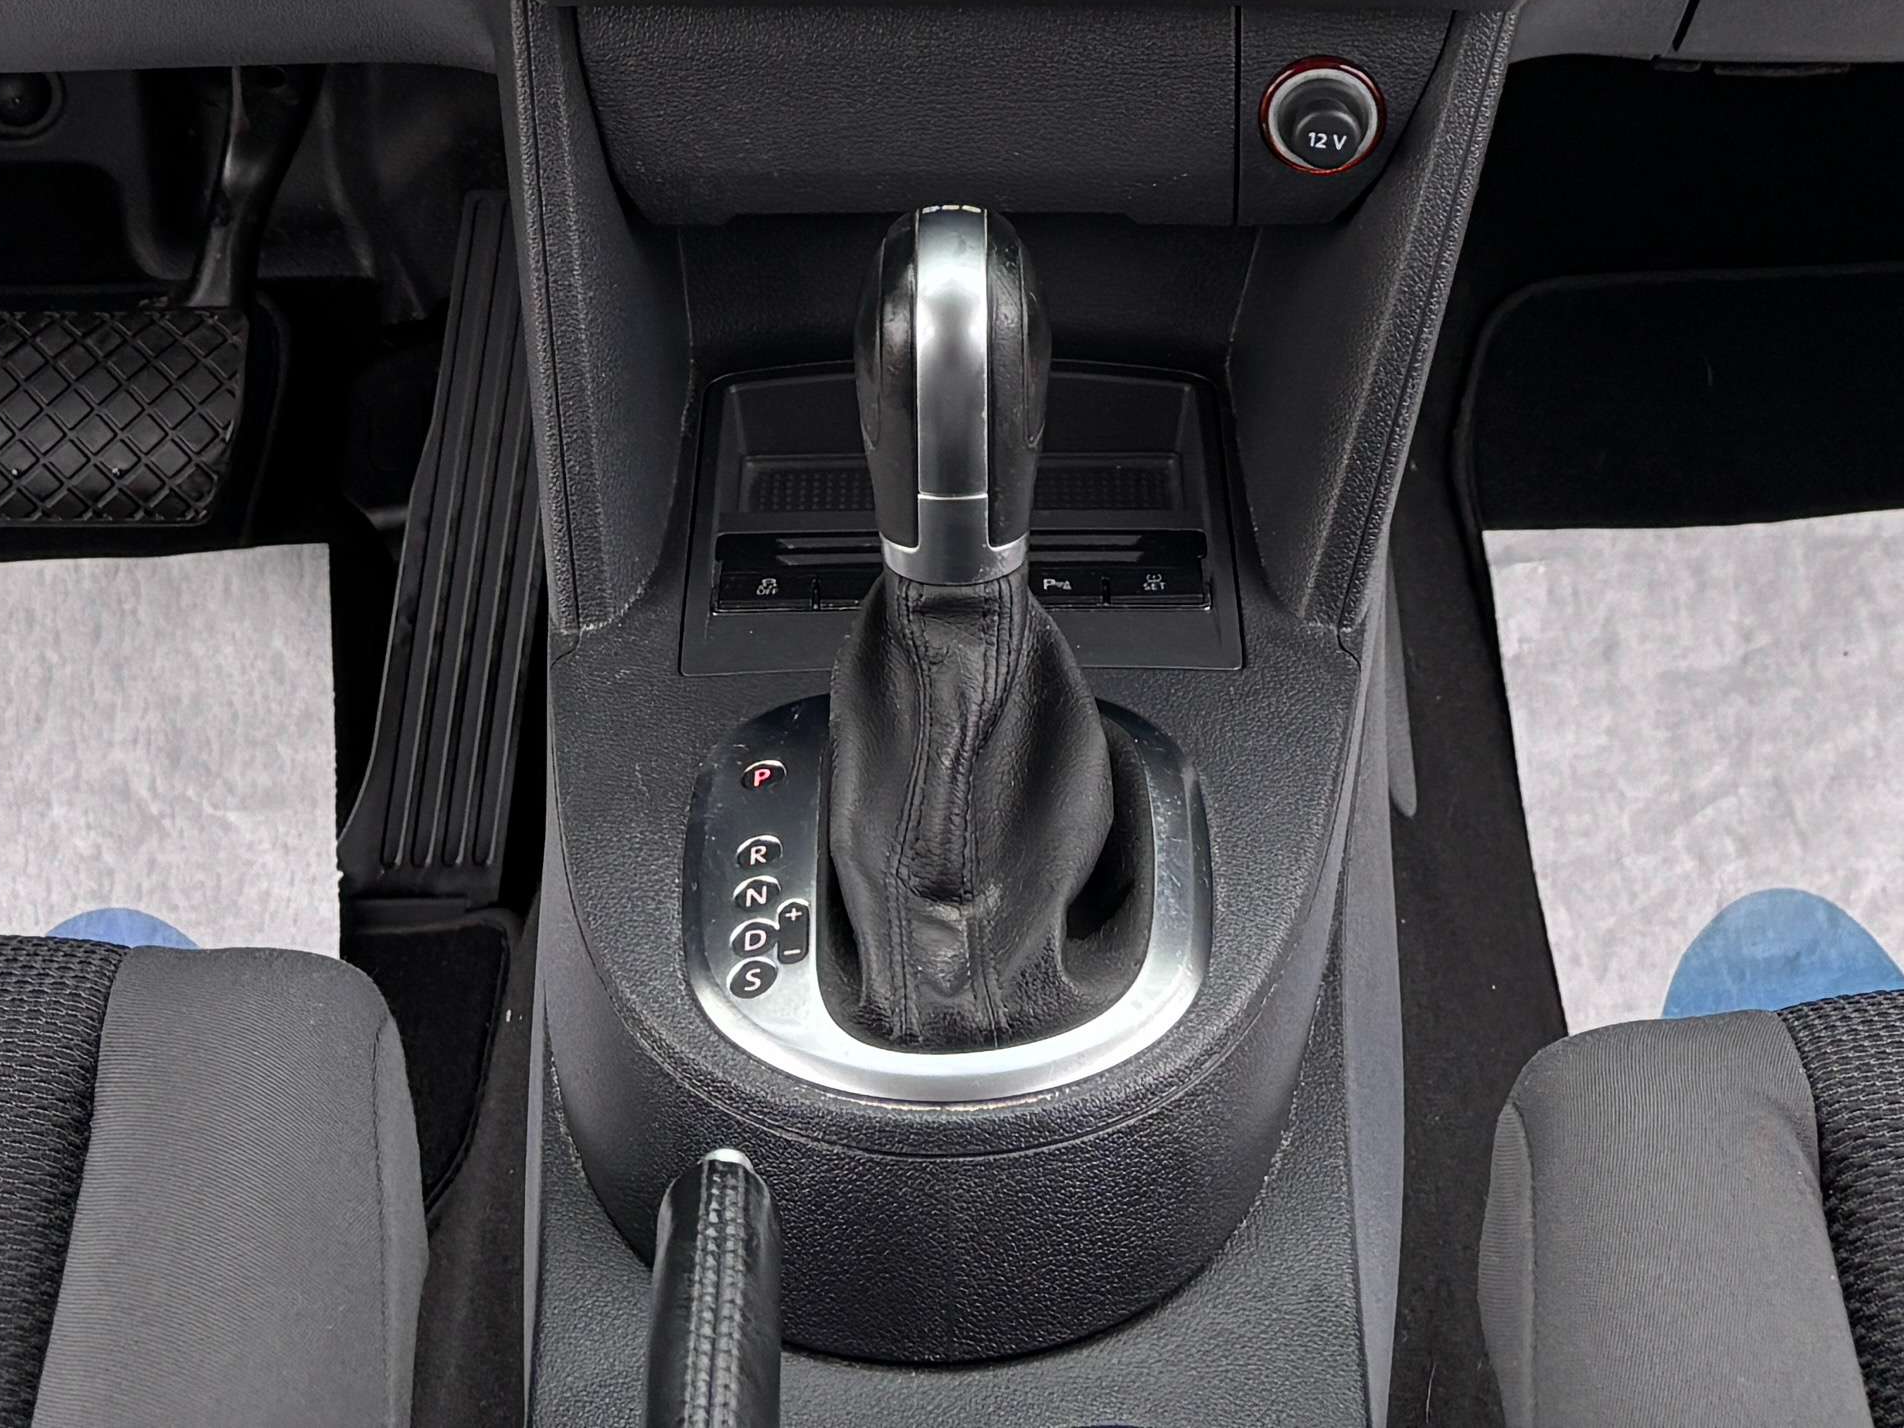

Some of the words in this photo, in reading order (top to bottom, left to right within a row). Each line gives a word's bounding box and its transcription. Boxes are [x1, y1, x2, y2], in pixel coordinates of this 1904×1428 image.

[1308, 131, 1328, 150] 12
[1332, 134, 1347, 150] V
[752, 768, 771, 788] P
[749, 845, 767, 866] R
[746, 885, 768, 908] N
[744, 929, 767, 952] D
[744, 968, 762, 992] S
